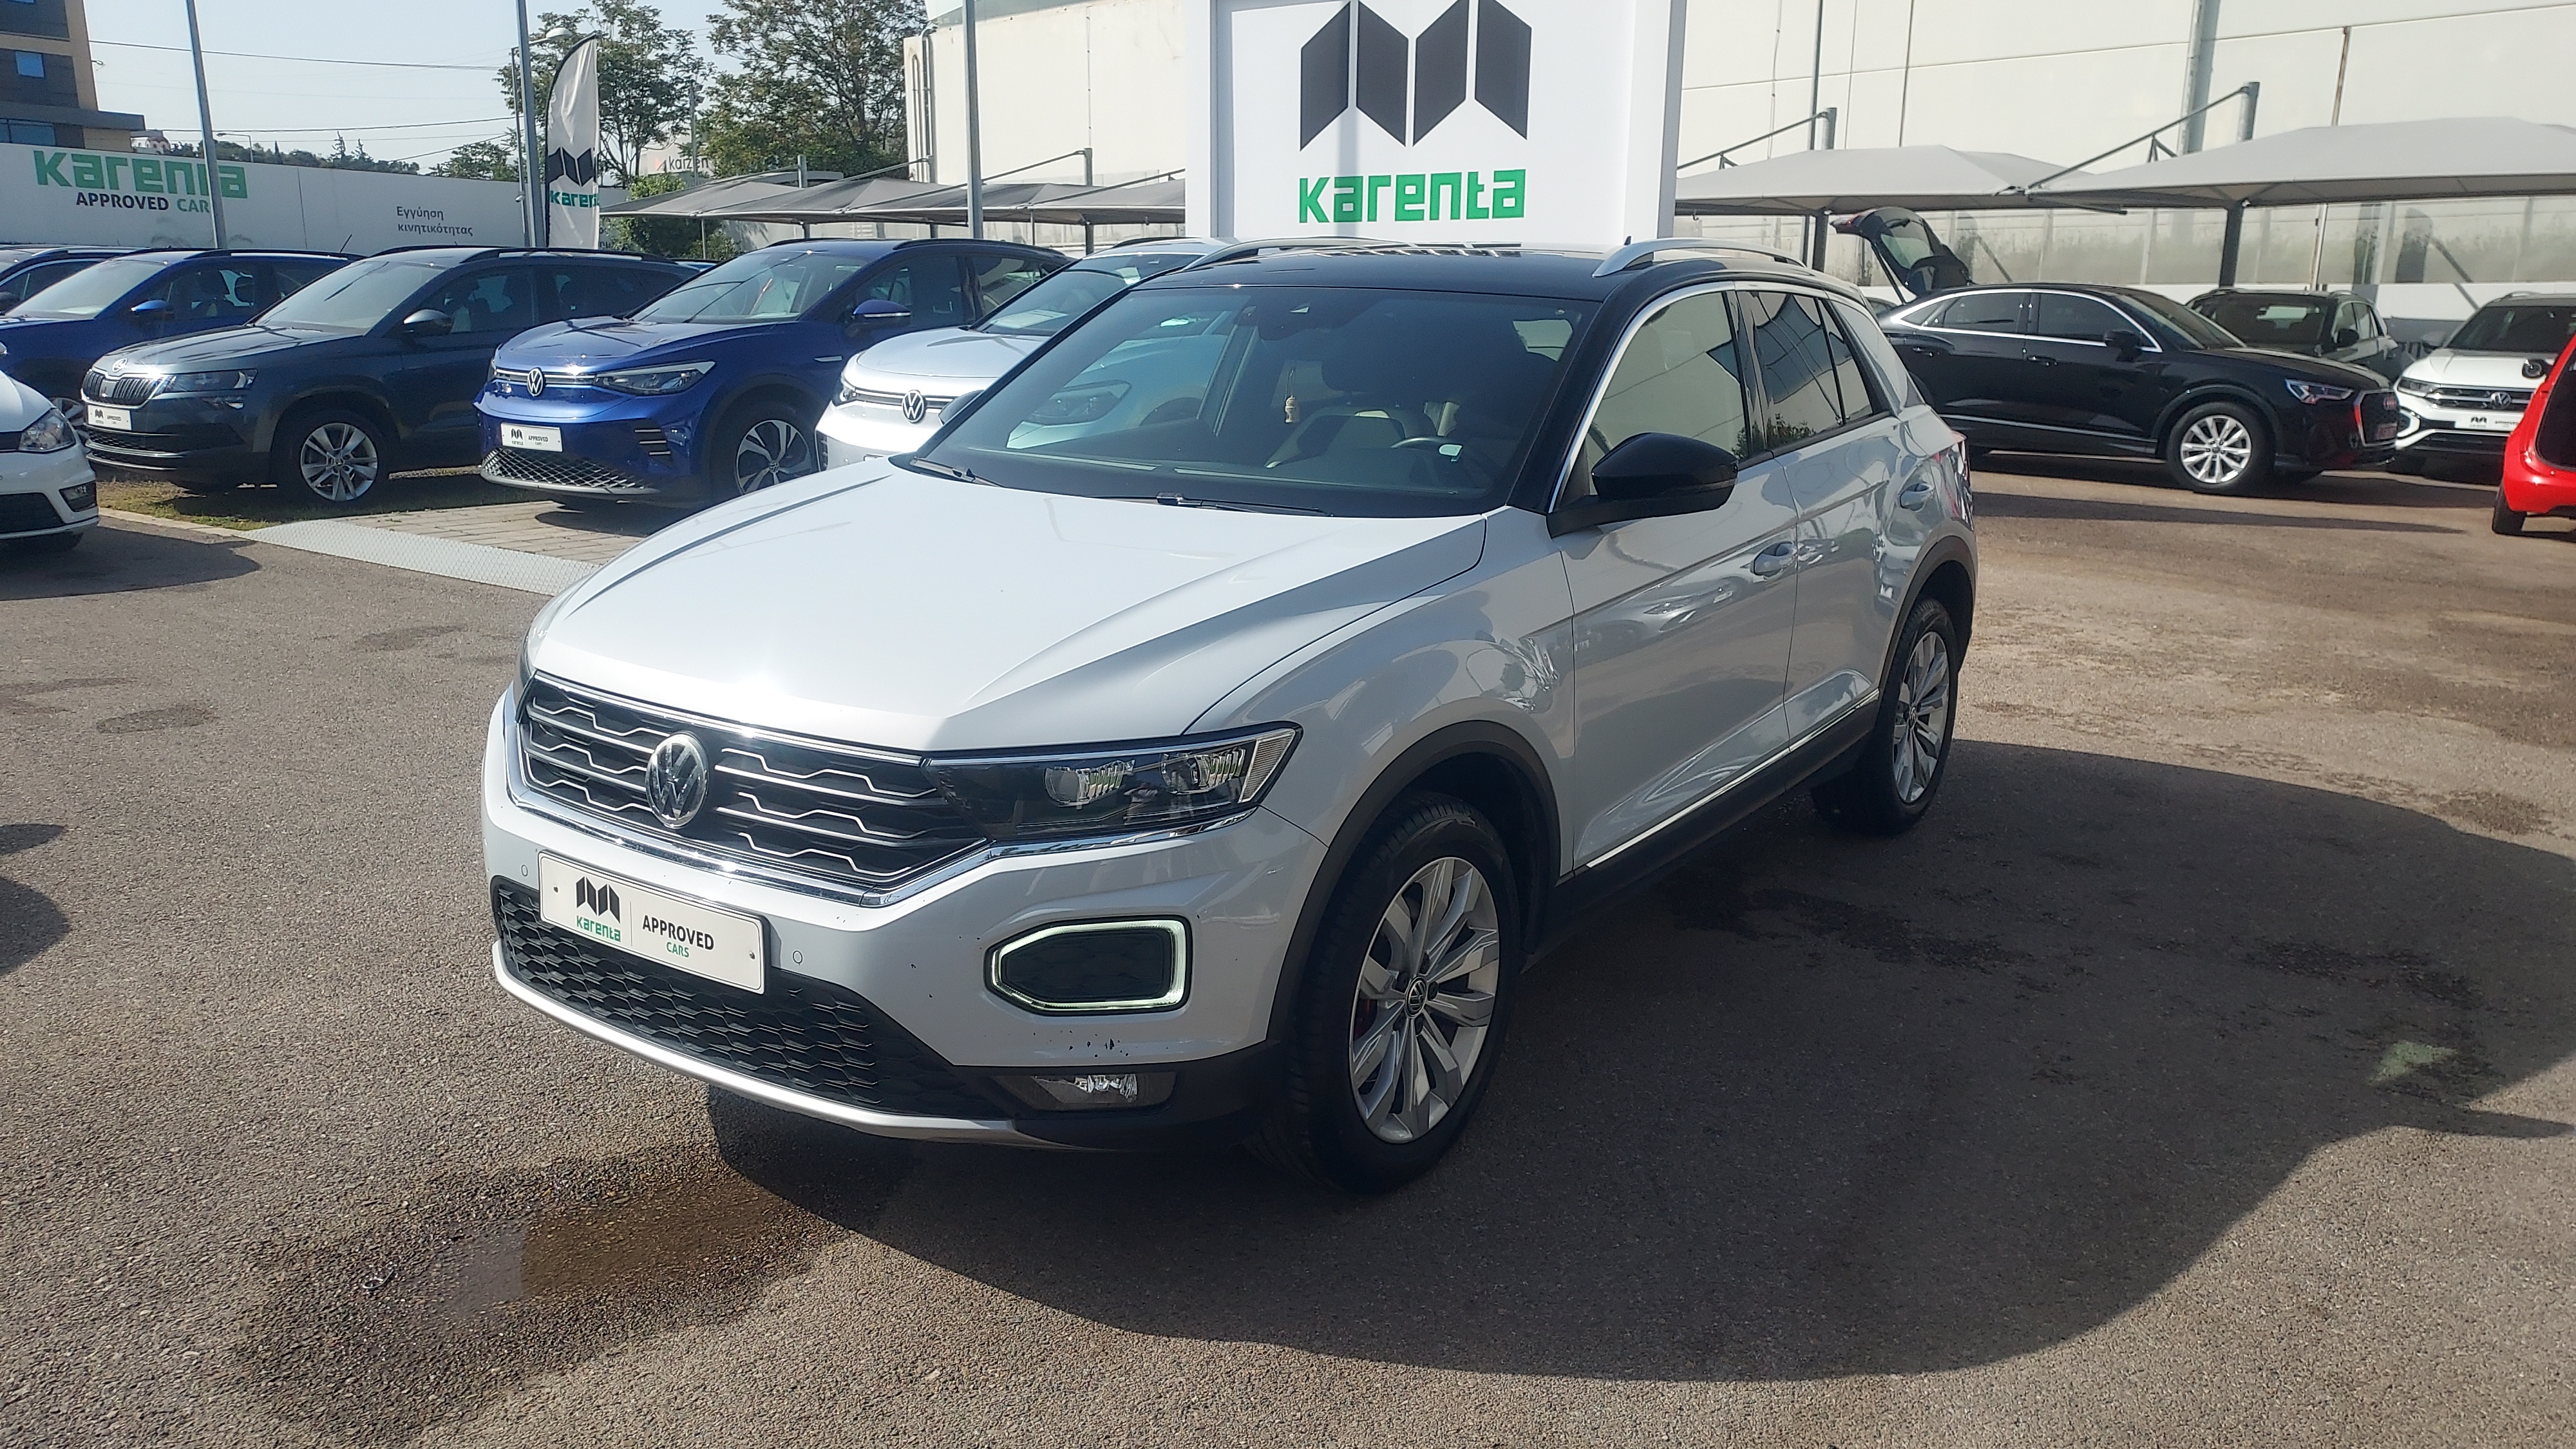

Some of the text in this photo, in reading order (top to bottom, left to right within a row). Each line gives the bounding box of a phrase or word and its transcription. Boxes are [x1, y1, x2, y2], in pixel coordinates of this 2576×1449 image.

[75, 192, 211, 213] APPROVED CAR
[397, 206, 444, 221] Εγγύηση
[398, 223, 473, 237] κινητικότητας
[642, 914, 714, 951] APPROVED
[667, 942, 690, 958] CARS
